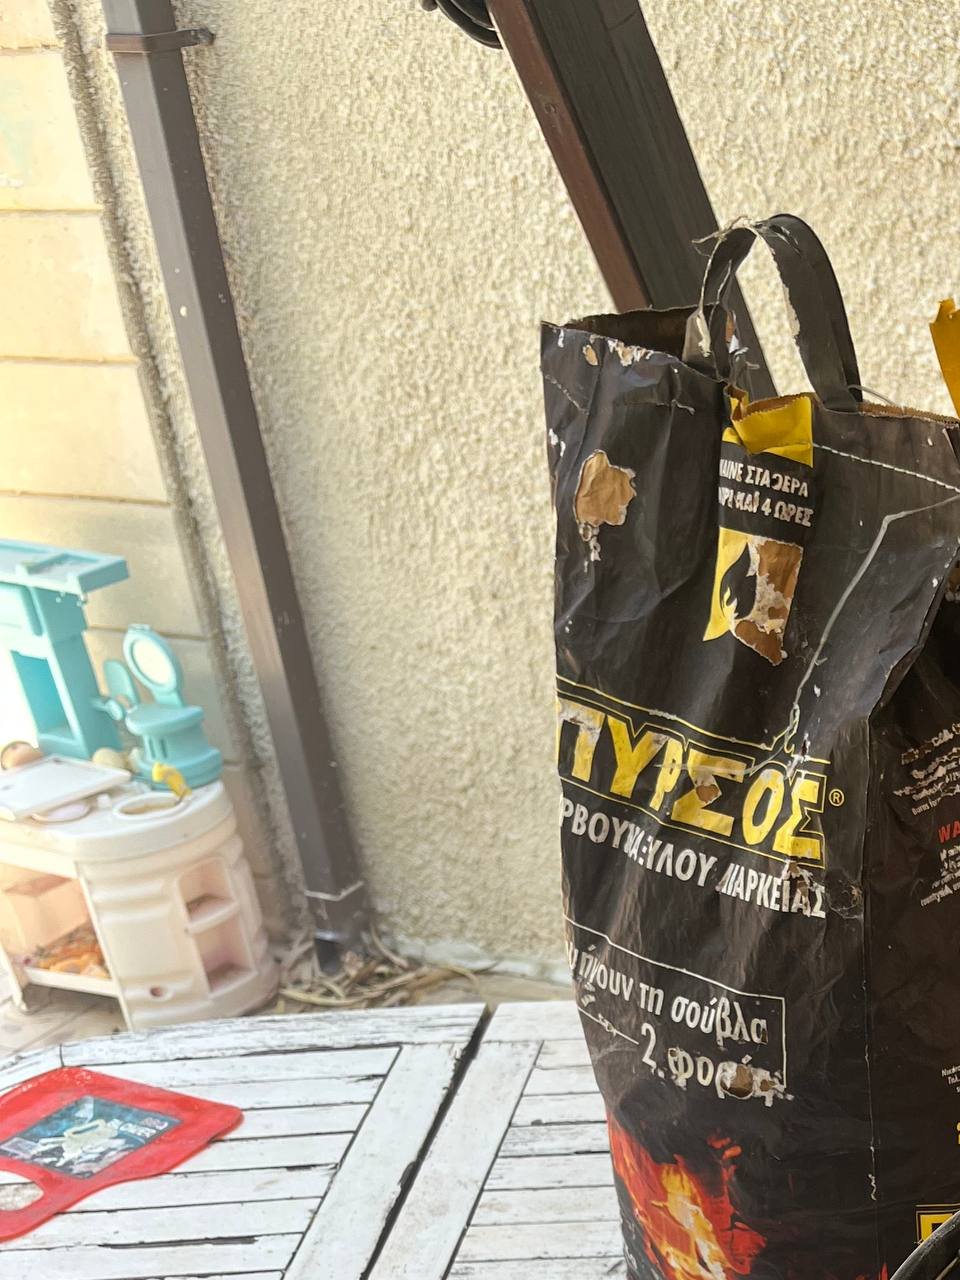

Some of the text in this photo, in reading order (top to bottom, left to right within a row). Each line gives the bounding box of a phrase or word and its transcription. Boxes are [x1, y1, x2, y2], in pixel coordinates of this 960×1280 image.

[761, 498, 772, 516] 4
[774, 501, 814, 527] ΩΡΕΣ
[639, 981, 665, 1016] τη
[671, 995, 768, 1047] σούβλα
